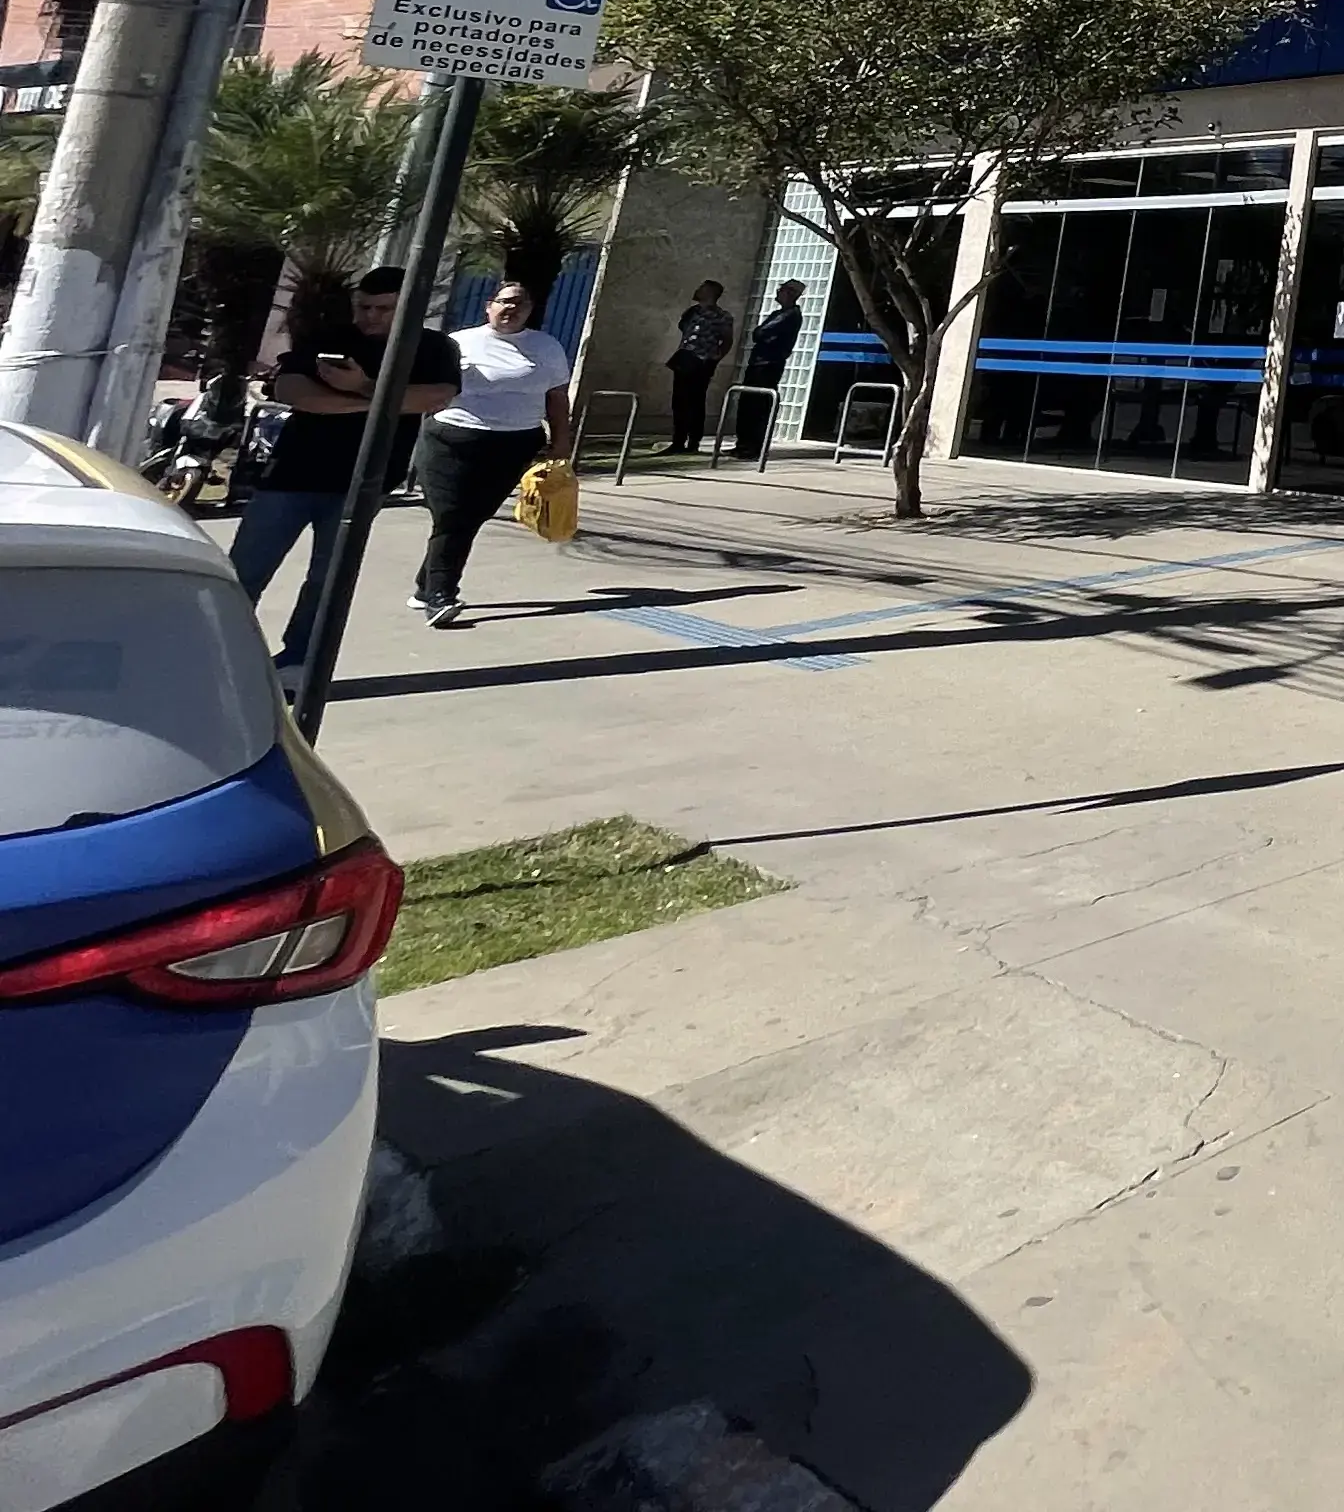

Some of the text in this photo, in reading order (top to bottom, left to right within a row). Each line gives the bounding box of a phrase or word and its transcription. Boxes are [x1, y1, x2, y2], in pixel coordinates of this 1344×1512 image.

[414, 20, 555, 50] portadores
[529, 19, 583, 38] para
[372, 32, 586, 70] de necessidades
[420, 53, 545, 81] especiais
